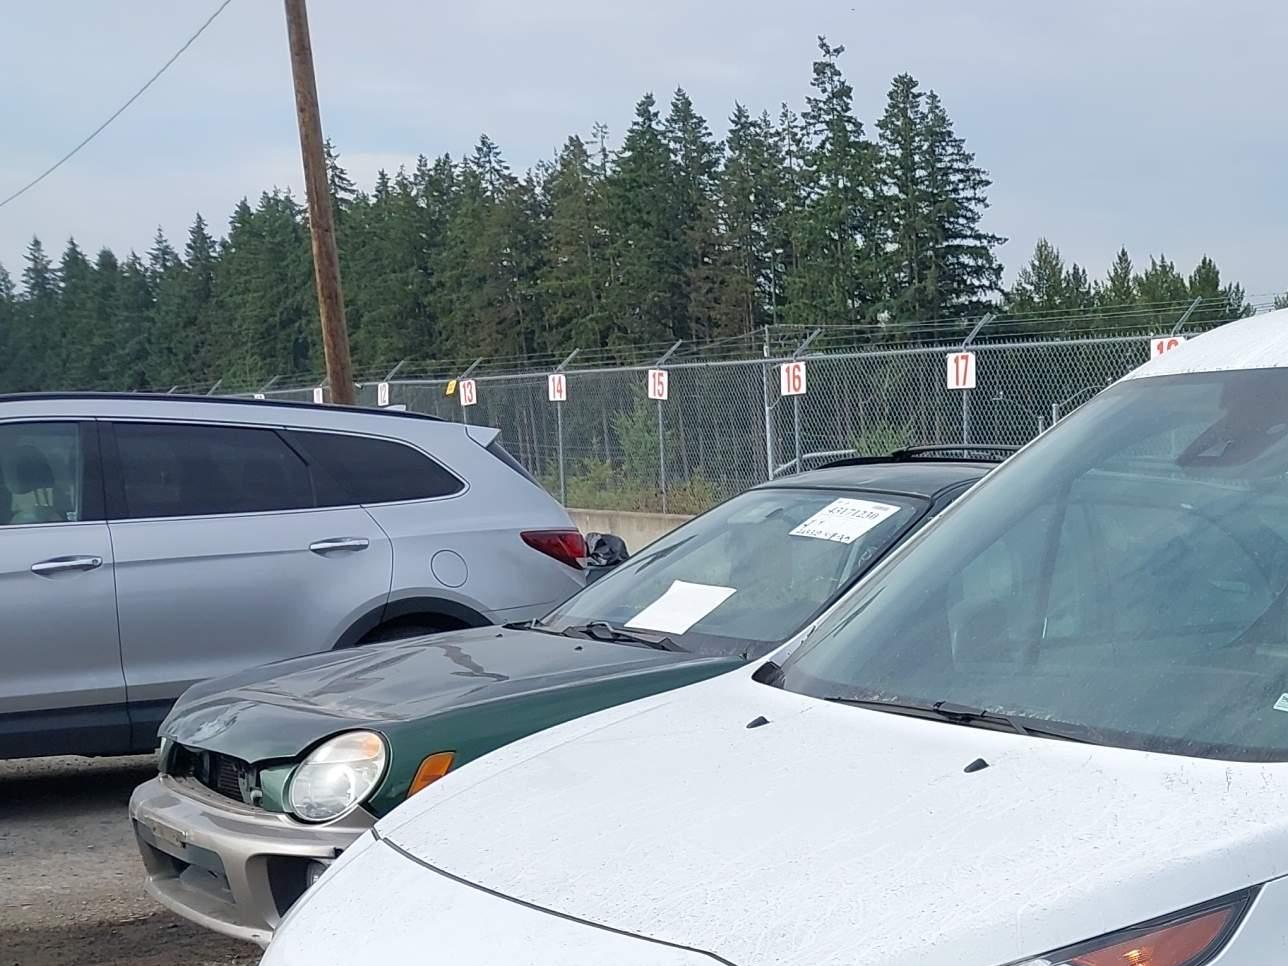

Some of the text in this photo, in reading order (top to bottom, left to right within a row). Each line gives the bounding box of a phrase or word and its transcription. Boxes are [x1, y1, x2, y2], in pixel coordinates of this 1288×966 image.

[785, 364, 801, 393] 16
[954, 354, 969, 387] 17
[463, 381, 473, 403] 13
[551, 375, 563, 399] 14
[652, 372, 664, 398] 15
